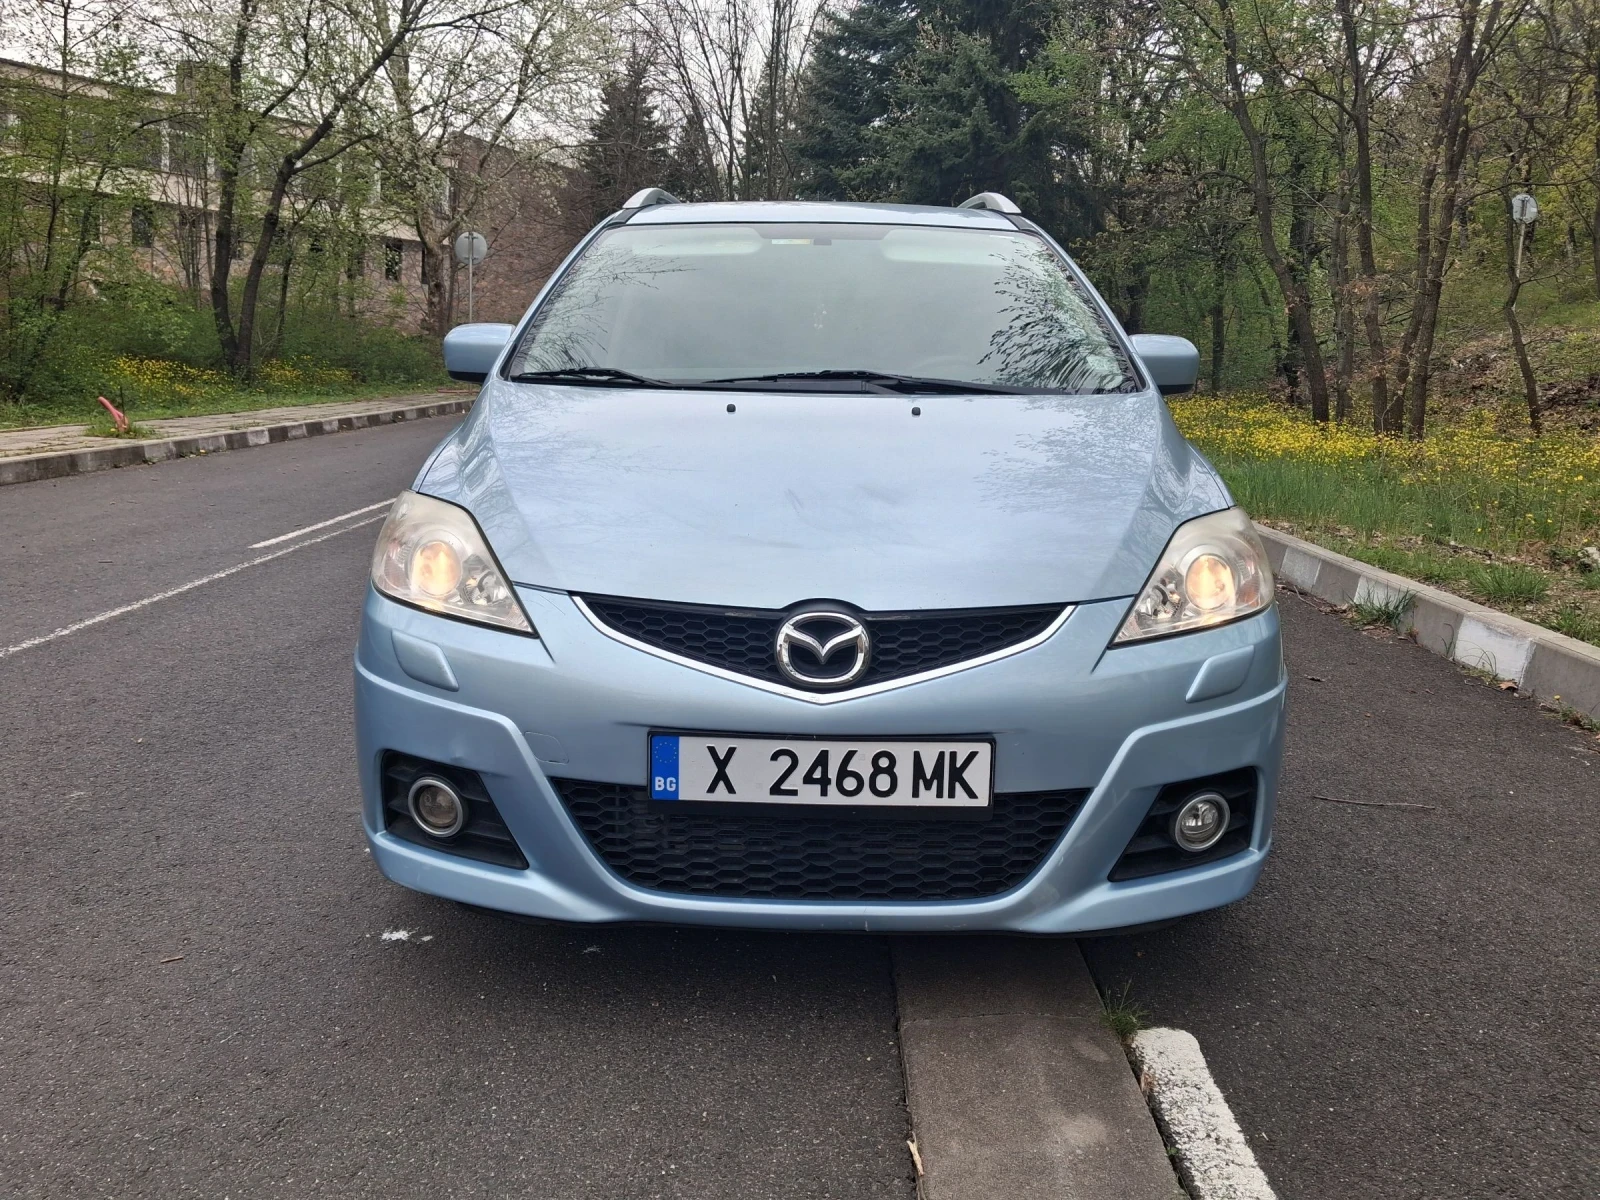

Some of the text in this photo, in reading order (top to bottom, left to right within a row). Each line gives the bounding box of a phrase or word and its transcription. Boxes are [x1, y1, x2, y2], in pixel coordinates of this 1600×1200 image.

[654, 776, 677, 791] BG
[769, 748, 898, 798] 2468
[911, 750, 980, 799] MK
